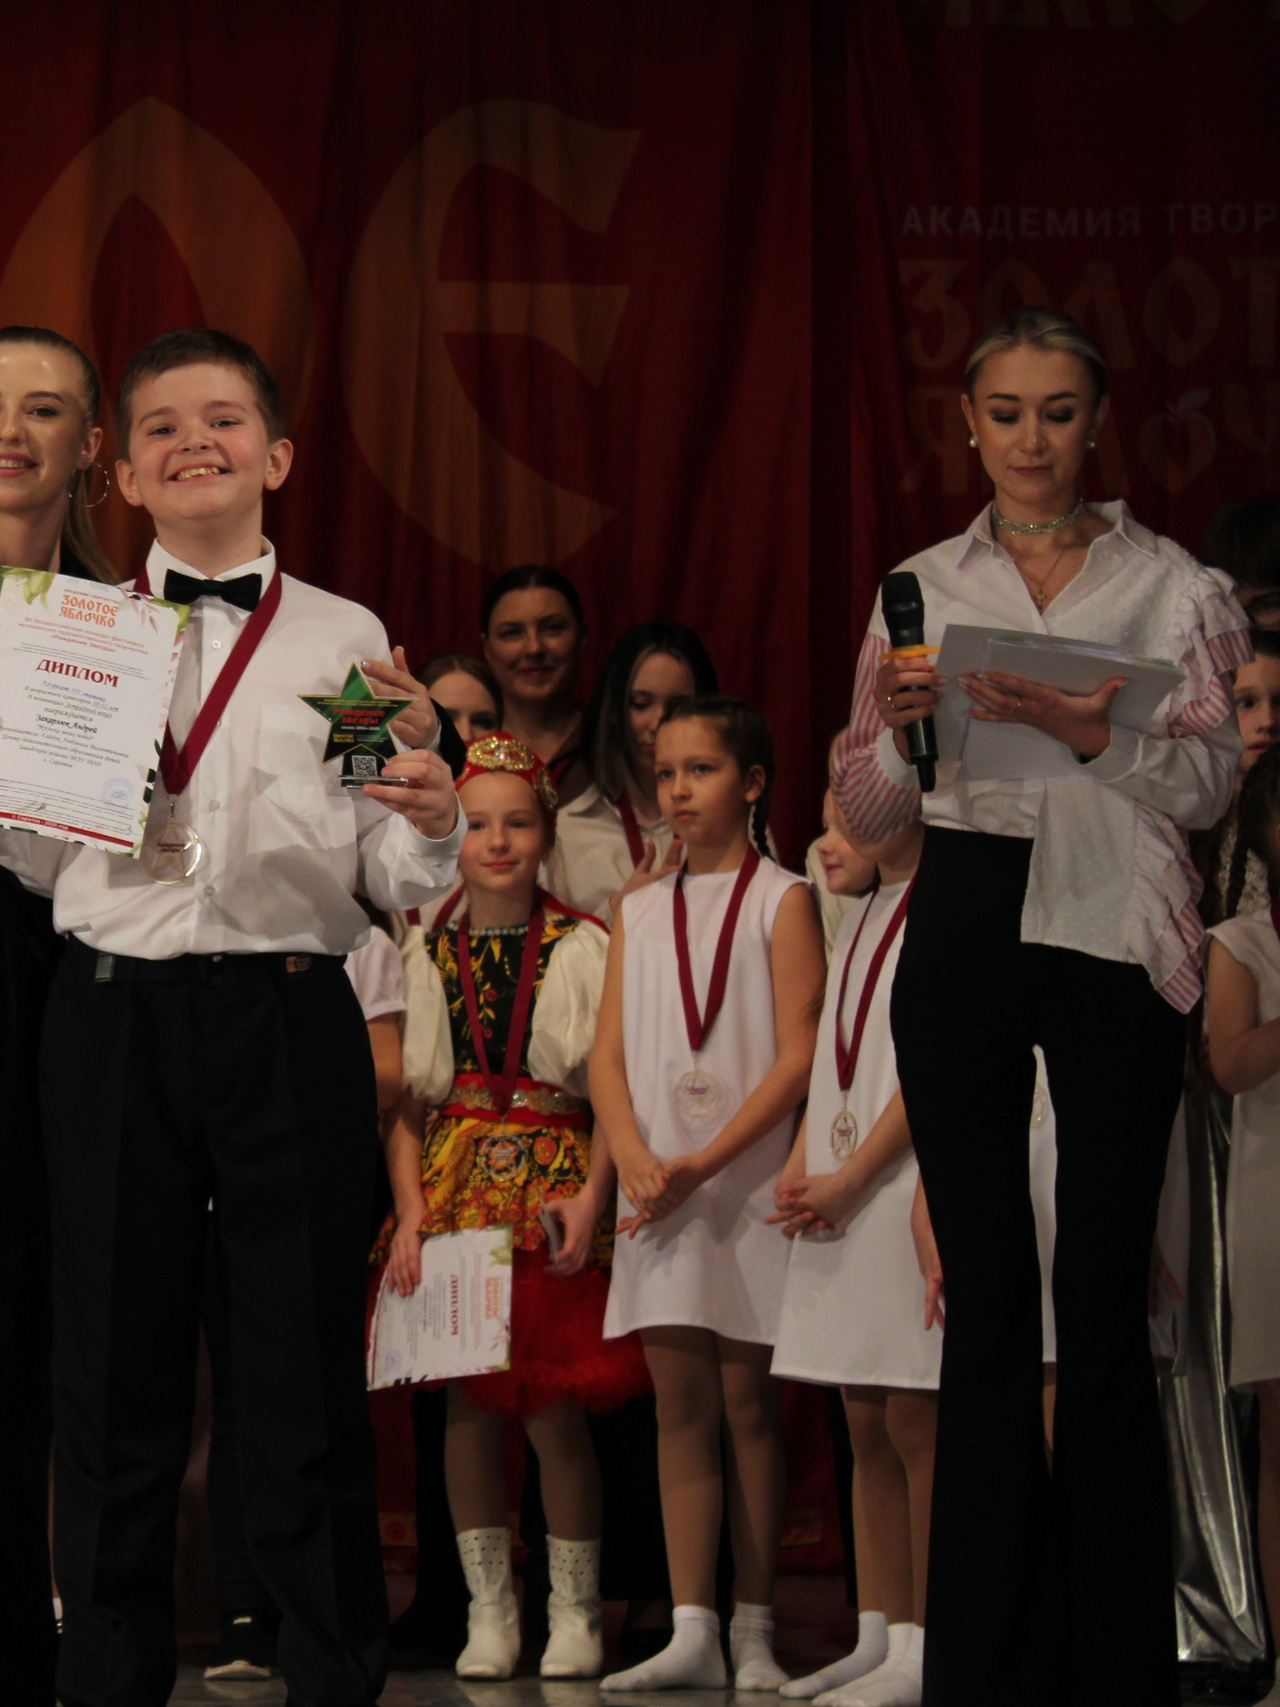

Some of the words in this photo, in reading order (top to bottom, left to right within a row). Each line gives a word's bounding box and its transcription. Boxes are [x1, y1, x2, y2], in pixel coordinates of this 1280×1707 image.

[901, 204, 1141, 243] АКАДЕМИЯ
[1165, 203, 1280, 236] ТВОР
[59, 606, 117, 628] ЯБЛОЧКО
[61, 594, 119, 617] ЗОЛОТОЕ
[36, 659, 119, 688] ДИПЛОМ
